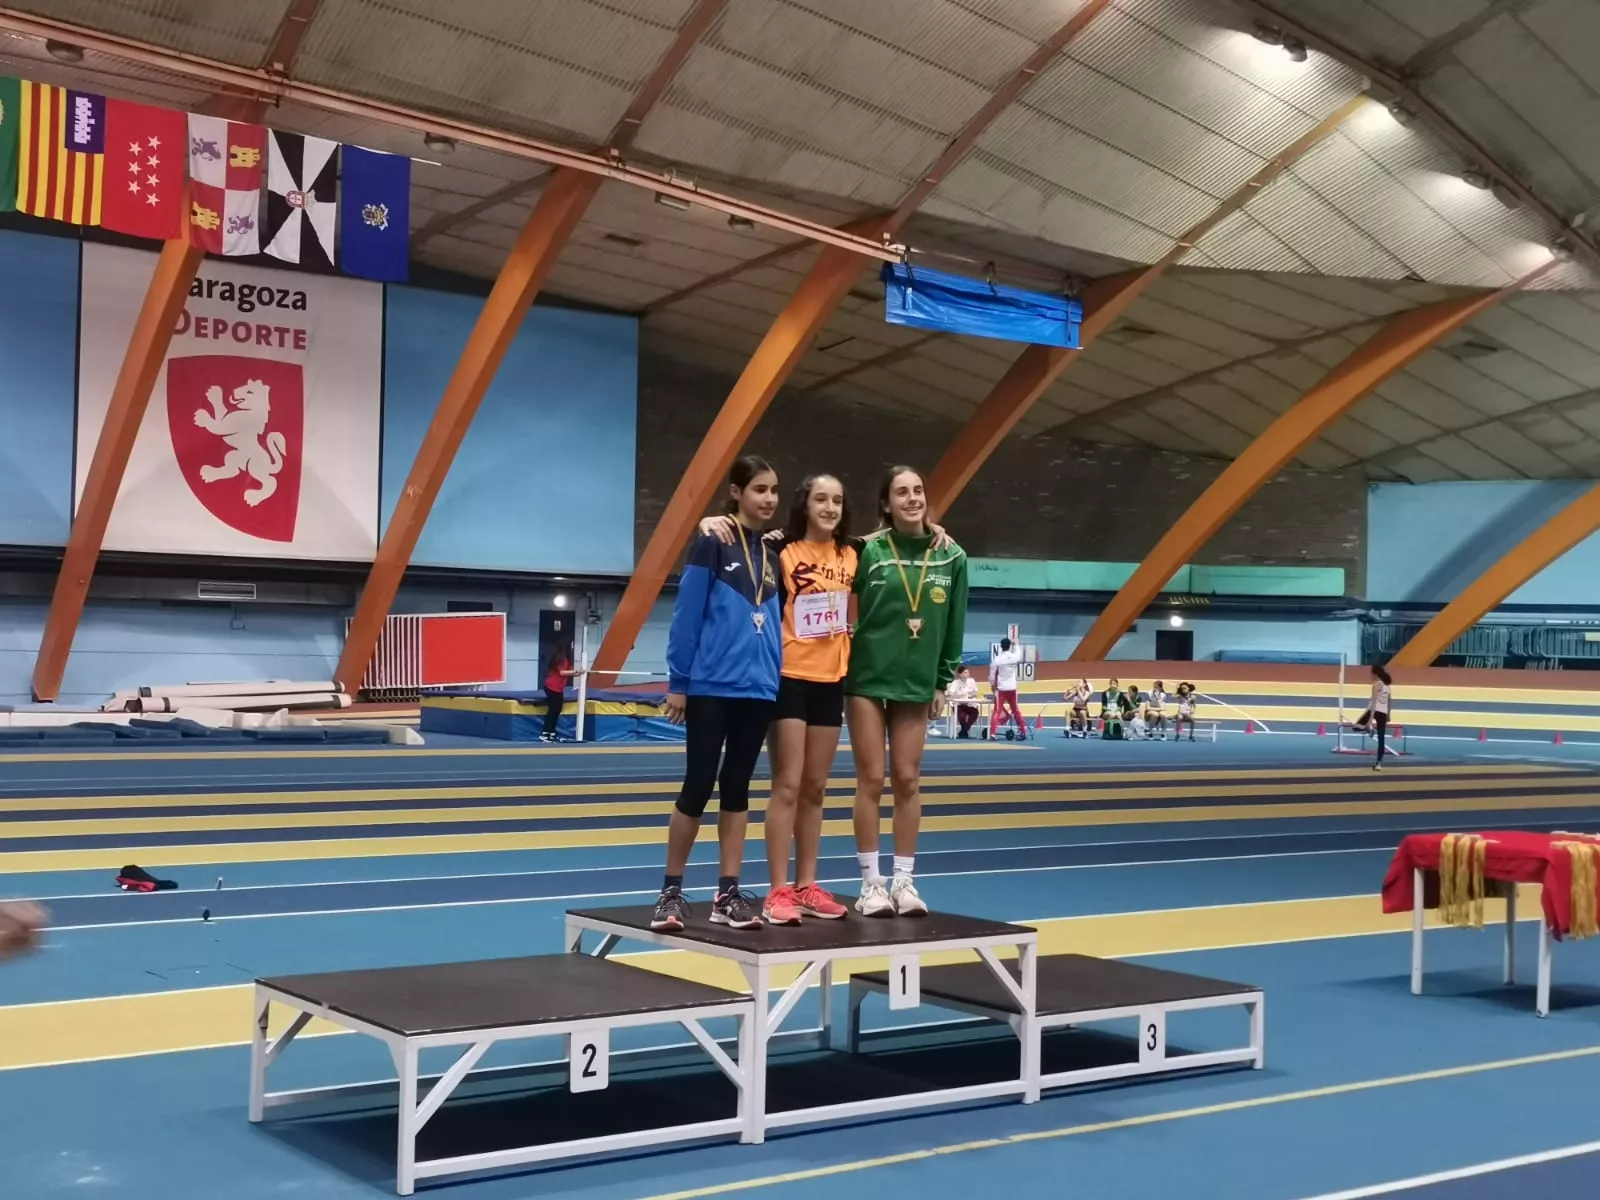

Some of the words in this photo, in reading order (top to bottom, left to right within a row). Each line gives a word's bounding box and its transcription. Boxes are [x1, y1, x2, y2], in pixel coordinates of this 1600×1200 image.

[189, 277, 307, 313] aragoza
[803, 609, 839, 626] 1761
[900, 965, 906, 995] 1
[1147, 1023, 1157, 1051] 3
[582, 1043, 597, 1078] 2
